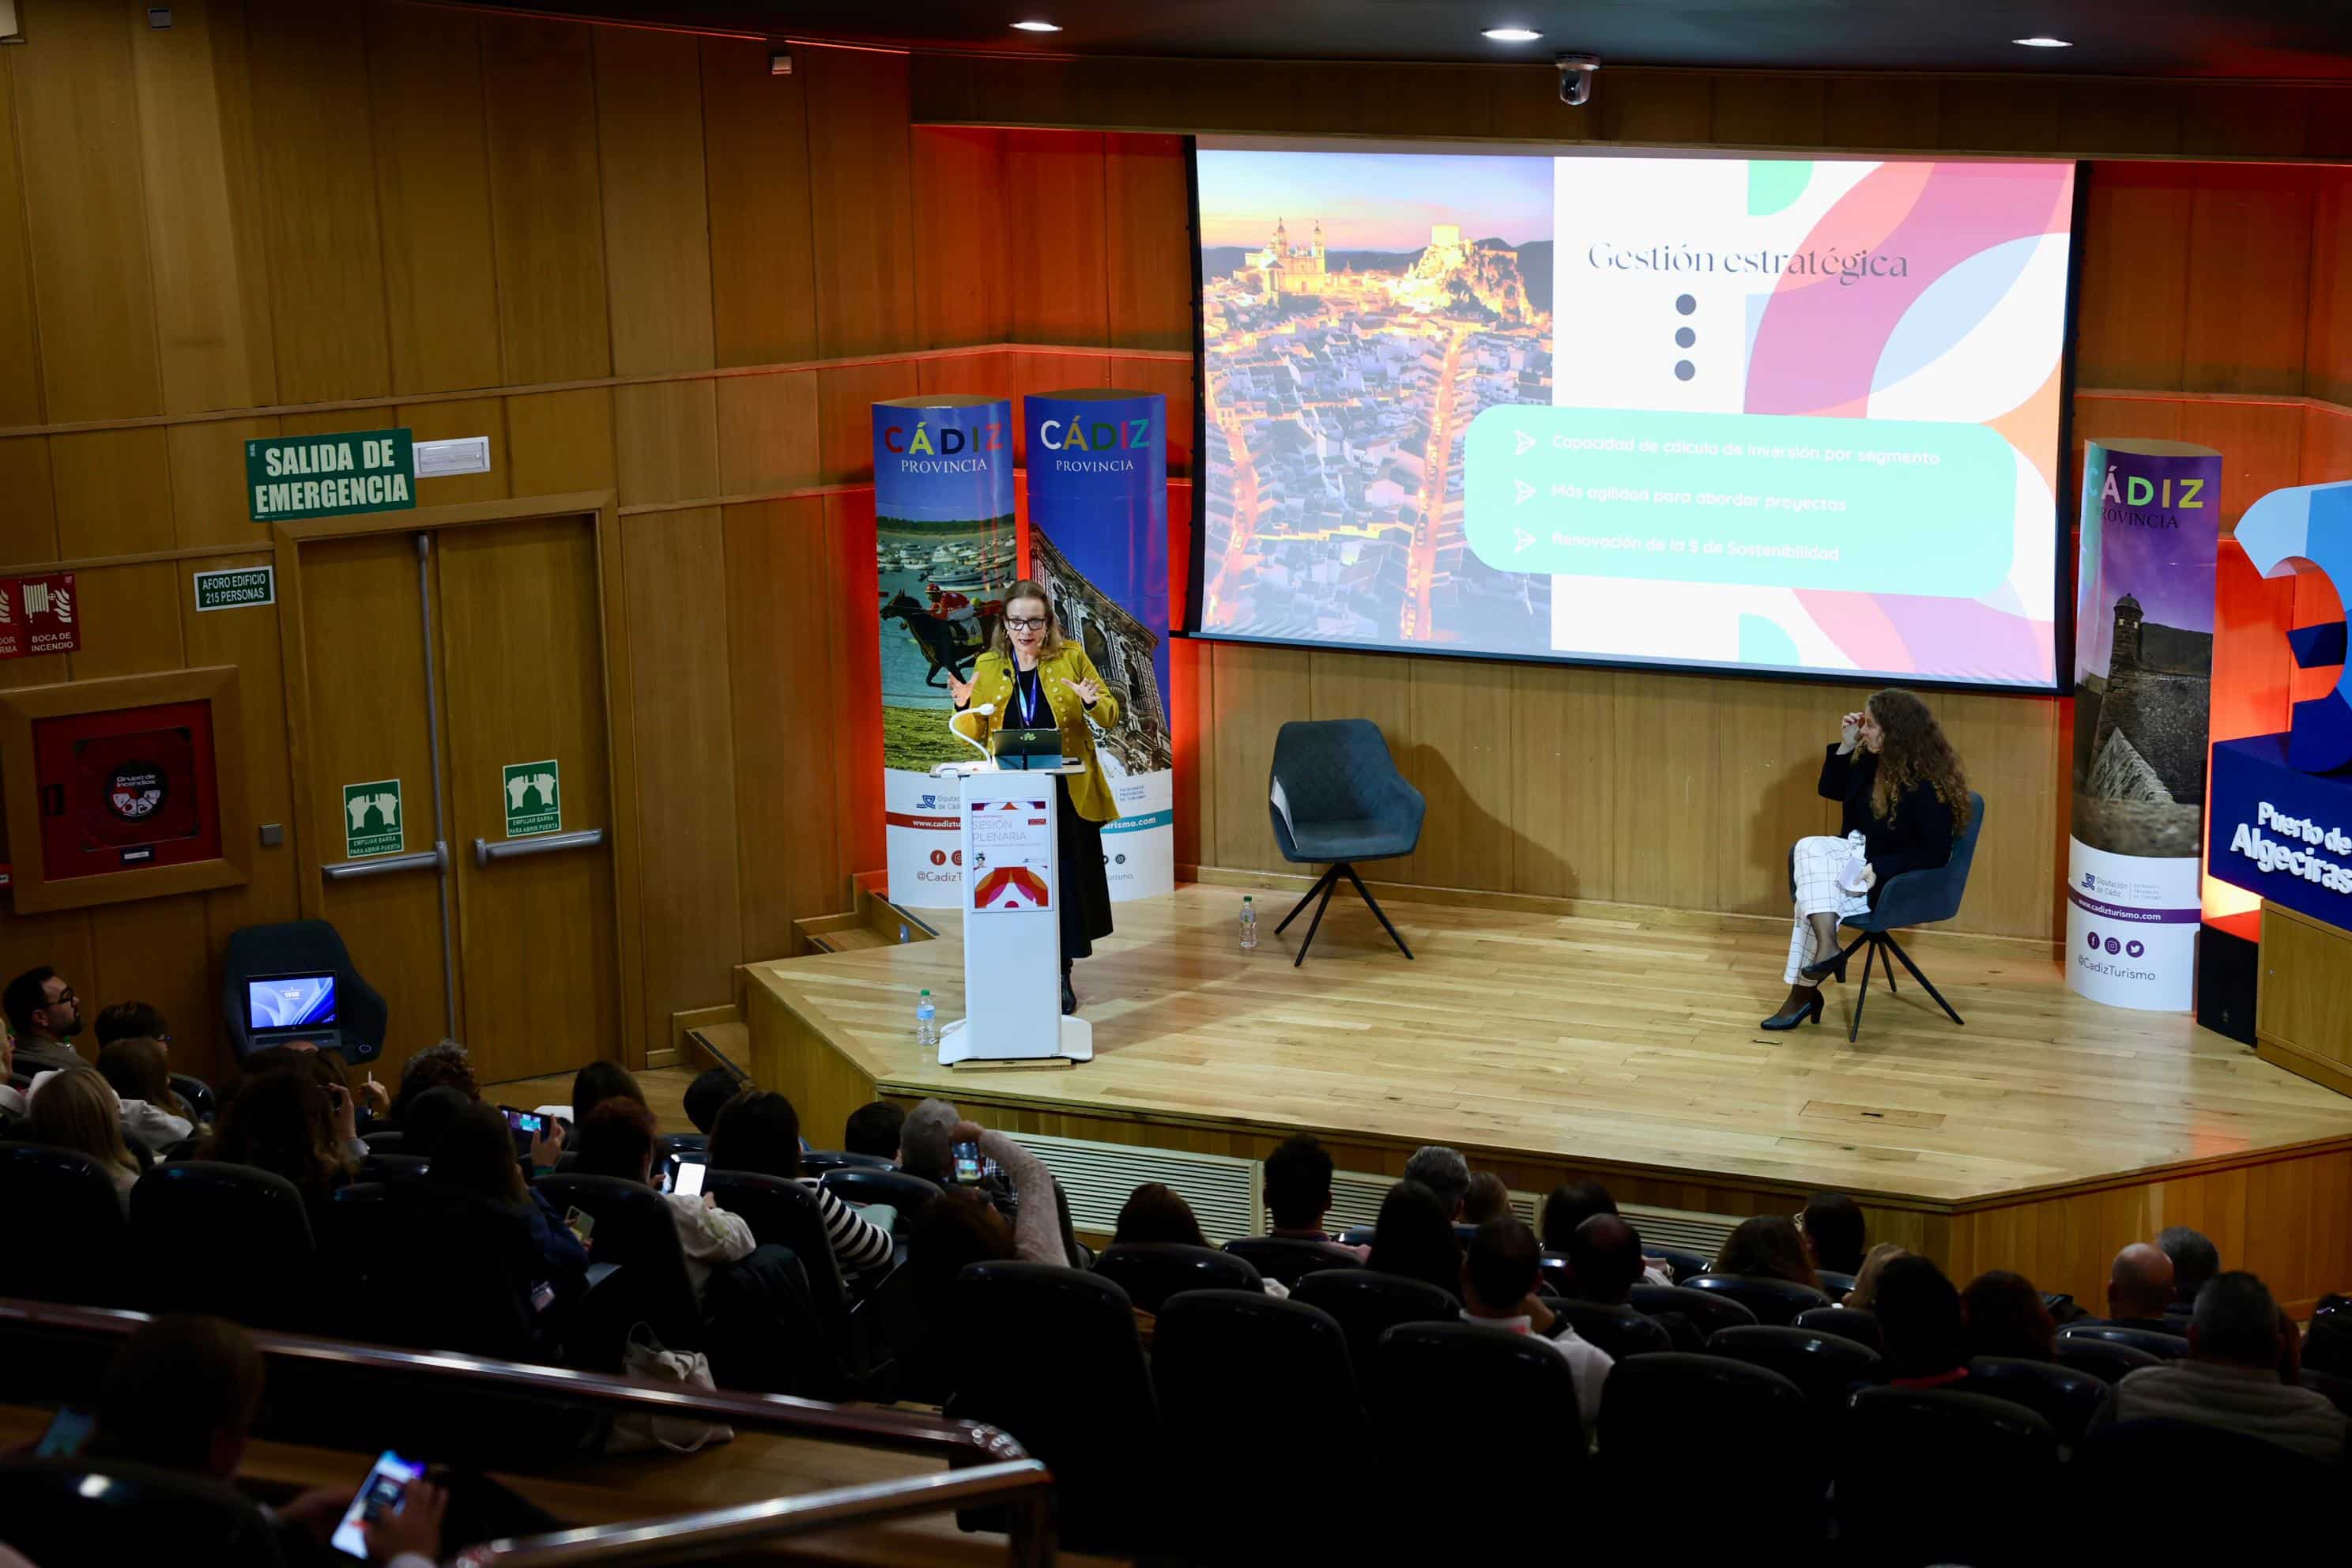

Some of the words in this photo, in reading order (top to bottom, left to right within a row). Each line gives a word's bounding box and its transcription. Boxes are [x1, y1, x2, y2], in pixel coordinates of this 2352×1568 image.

[1589, 241, 1713, 272] Gestión
[1724, 247, 1908, 286] estratégica
[884, 421, 1004, 455] CÁDIZ
[1040, 415, 1151, 451] CÁDIZ
[265, 443, 354, 477] SALIDA
[362, 439, 395, 469] DE
[1551, 435, 1634, 453] Capacidad
[1638, 437, 1658, 453] de
[1663, 437, 1720, 455] cálculo
[1723, 439, 1743, 456] de
[1747, 441, 1821, 461] inversión
[1824, 447, 1854, 463] por
[1858, 447, 1943, 466] segmento
[901, 458, 987, 474] PROVINCIA
[1056, 459, 1135, 473] PROVINCIA
[255, 473, 409, 514] EMERGENCIA
[1551, 483, 1583, 499] Más
[1586, 486, 1649, 503] agilidad
[1653, 491, 1692, 507] para
[1695, 488, 1761, 507] abordar
[2089, 465, 2205, 509] CÁDIZ
[2100, 508, 2180, 529] ROVINCIA
[1551, 531, 1642, 551] Renovación
[1645, 537, 1665, 551] de
[1669, 537, 1685, 552] la
[1703, 539, 1724, 555] de
[1726, 539, 1841, 561] Sostenibilidad
[202, 577, 231, 590] AFORO
[232, 573, 266, 586] EDIFICIO
[205, 593, 220, 604] 215
[221, 587, 265, 601] PERSONAS
[32, 634, 57, 643] BOCA
[32, 641, 74, 652] INCENDIO
[973, 832, 1027, 842] PLENARIA
[2258, 801, 2324, 845] Puerto
[2324, 827, 2352, 856] de
[2230, 823, 2352, 894] Algeciras
[917, 872, 962, 882] @CadizT
